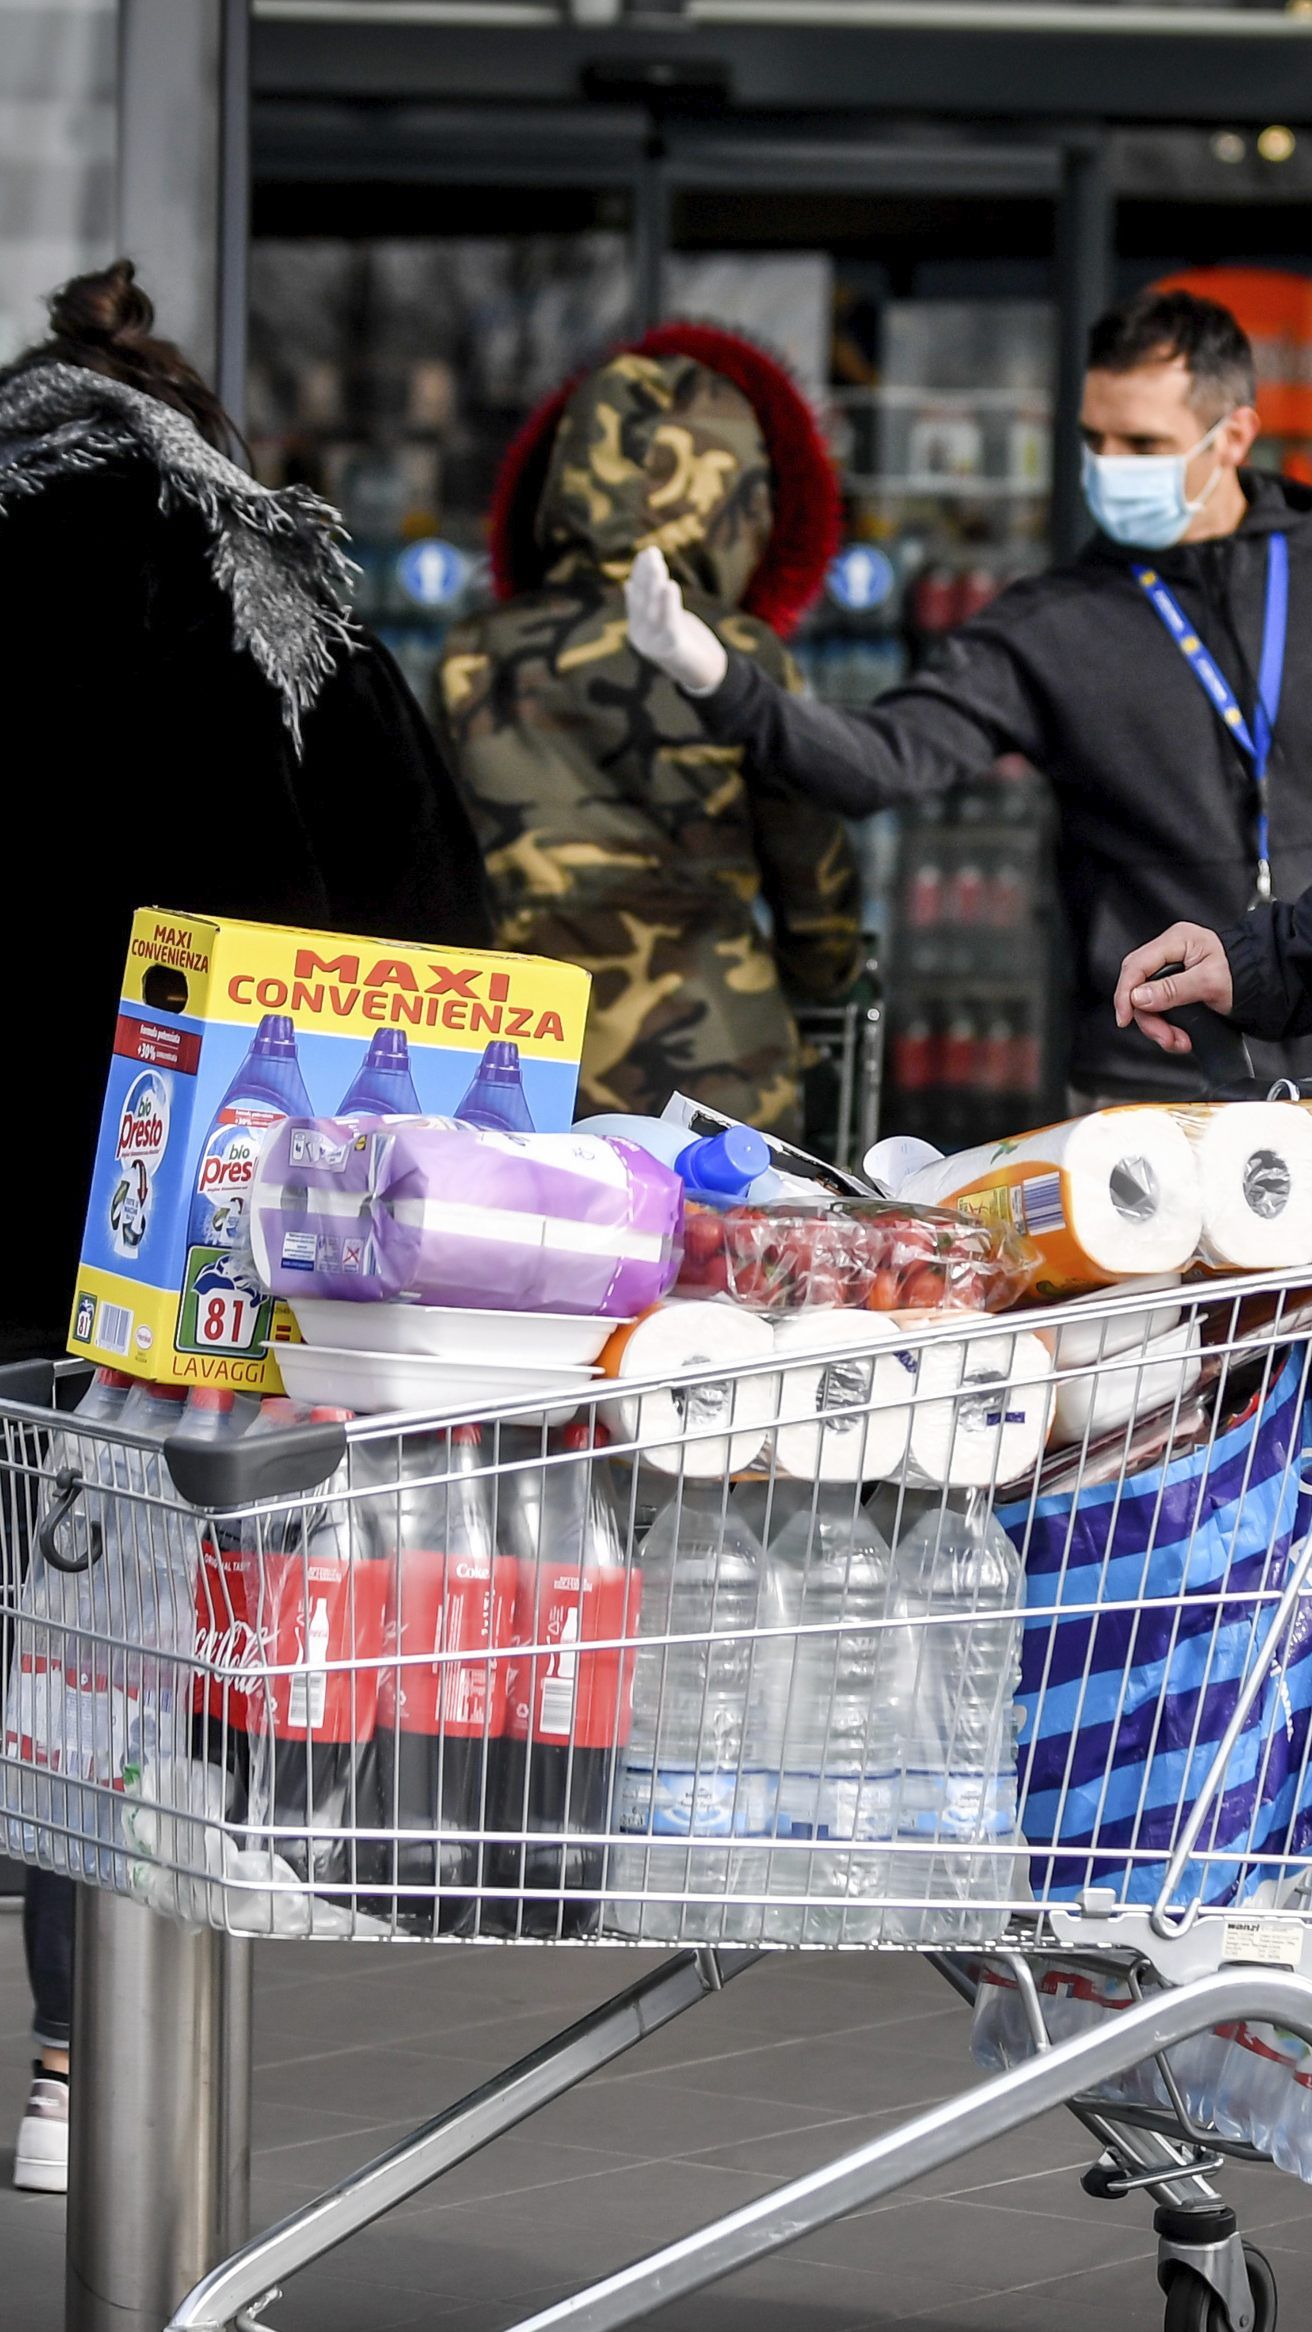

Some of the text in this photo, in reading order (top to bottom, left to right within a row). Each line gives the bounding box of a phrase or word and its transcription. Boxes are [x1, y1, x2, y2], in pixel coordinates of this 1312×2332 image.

[154, 924, 192, 949] MAXI
[131, 938, 209, 973] CONVENIENZA
[294, 949, 510, 1003] MAXI
[228, 974, 565, 1042] CONVENIENZA
[229, 1144, 250, 1160] bio
[78, 1315, 90, 1338] 81
[204, 1297, 244, 1343] 81
[172, 1355, 265, 1384] LAVAGGI
[456, 1562, 490, 1580] Coke
